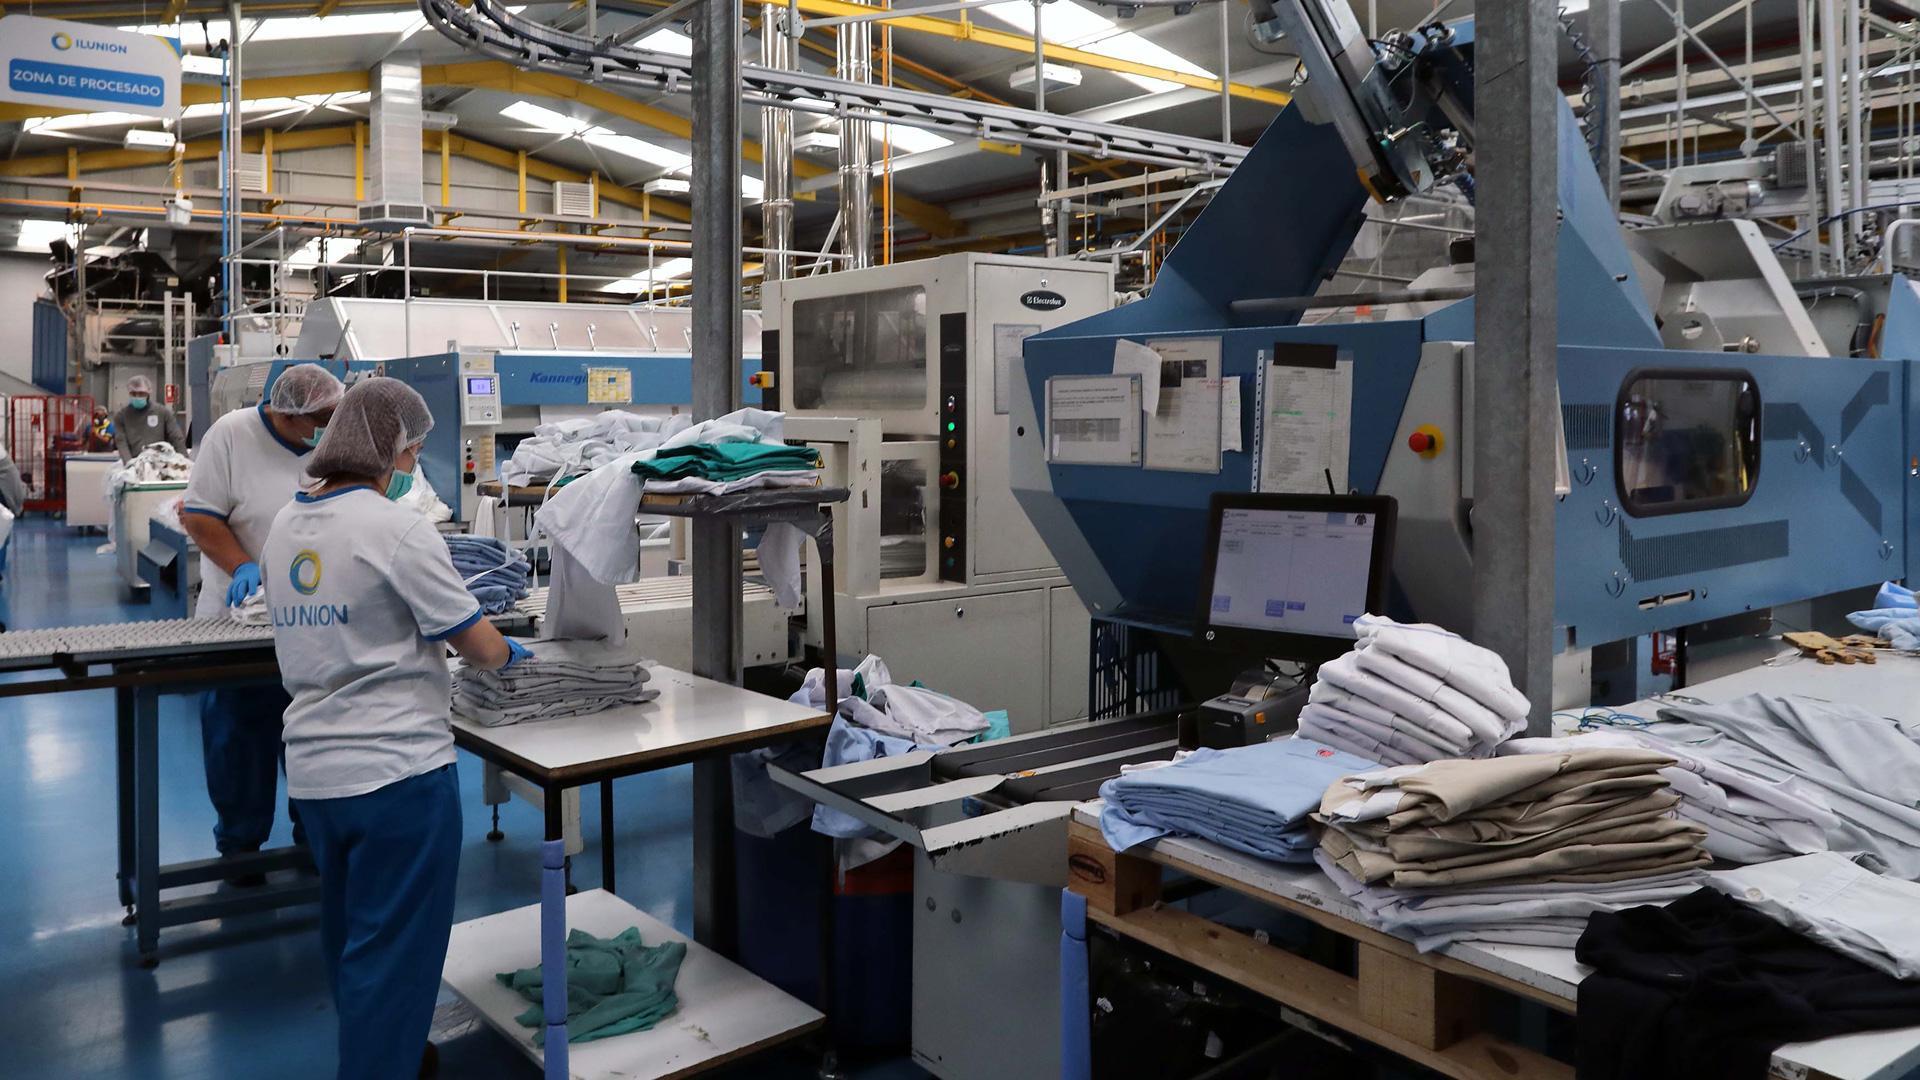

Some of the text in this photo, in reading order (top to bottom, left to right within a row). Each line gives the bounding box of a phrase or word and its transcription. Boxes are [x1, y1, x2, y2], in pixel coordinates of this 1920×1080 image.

[76, 39, 128, 54] ILUNION
[13, 69, 161, 97] ZONA DE PROCESADO
[272, 603, 349, 627] LUNION
